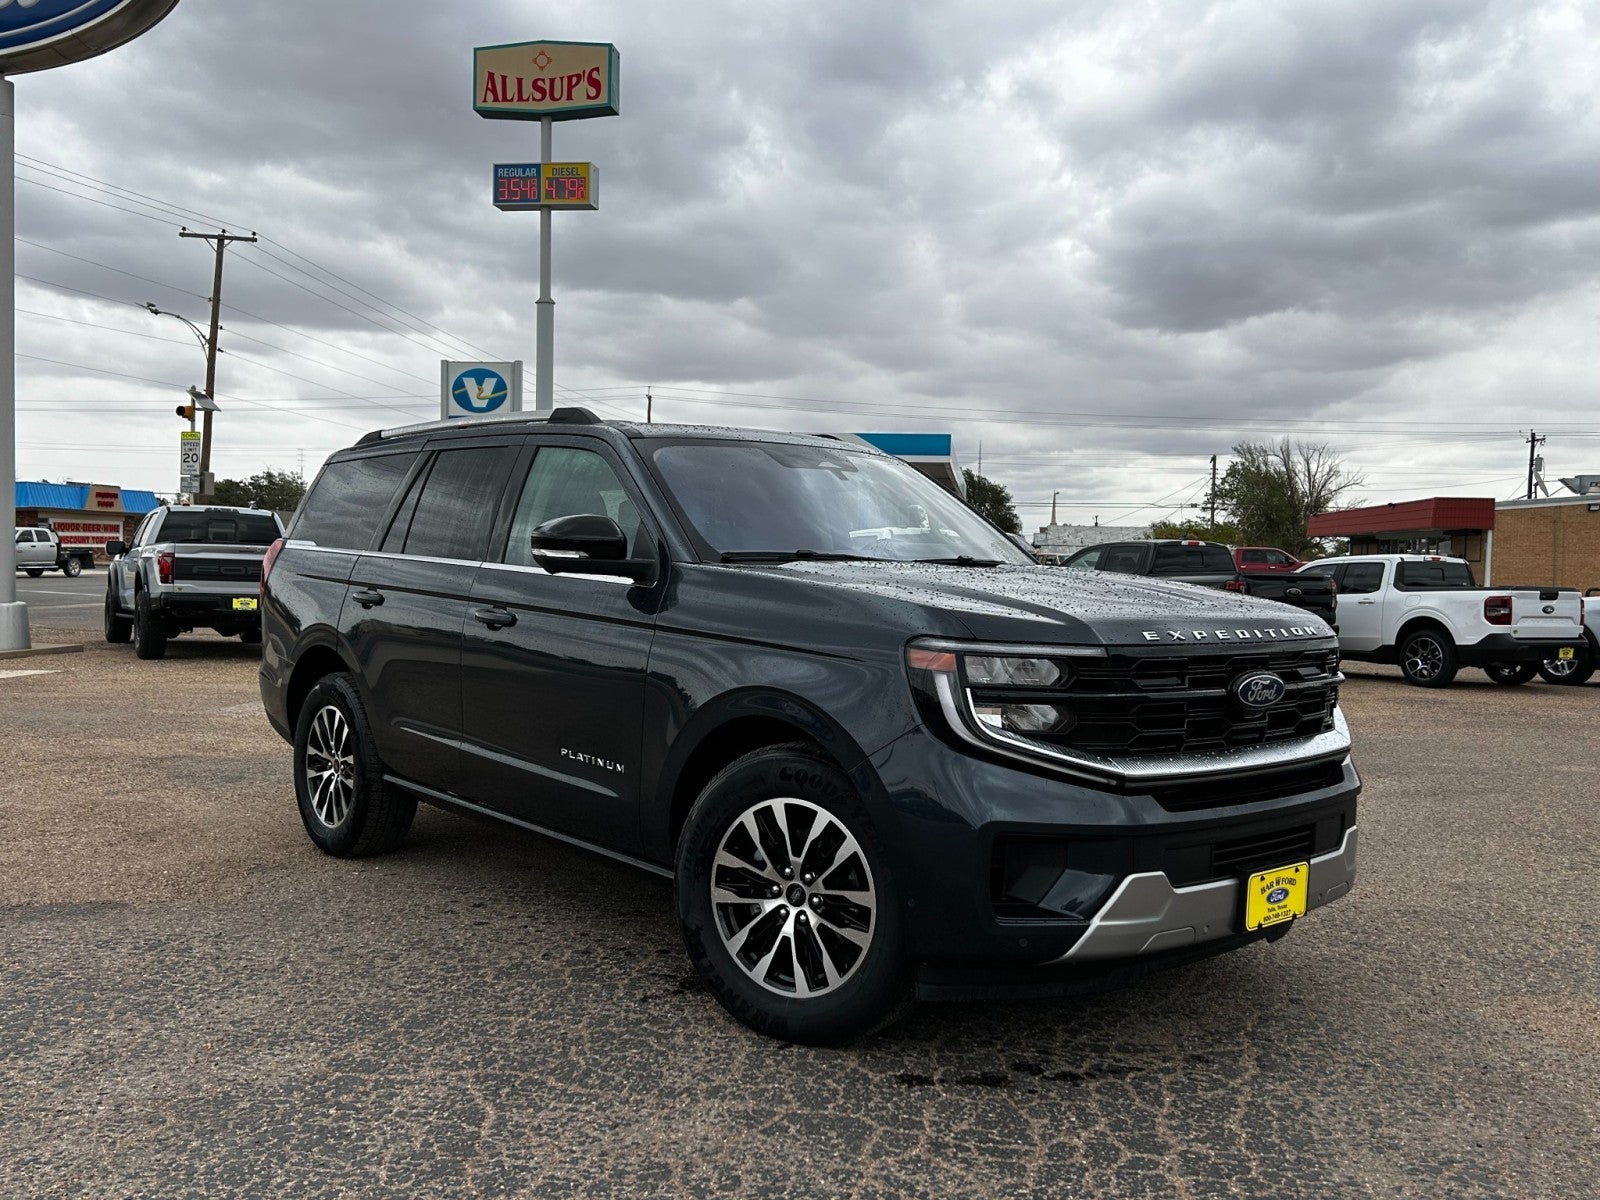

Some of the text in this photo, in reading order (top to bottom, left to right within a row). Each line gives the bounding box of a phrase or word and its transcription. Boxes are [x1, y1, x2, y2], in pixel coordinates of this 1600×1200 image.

[482, 66, 602, 103] ALLSUP'S
[498, 167, 537, 177] REGULAR
[552, 167, 581, 176] DIESEL
[183, 453, 198, 463] 20
[1142, 626, 1318, 641] EXPEDITION
[1247, 679, 1278, 701] Ford
[560, 747, 625, 774] PLATINUM
[1260, 881, 1275, 895] BAR
[1281, 877, 1297, 886] FORD
[1270, 889, 1286, 902] Ford
